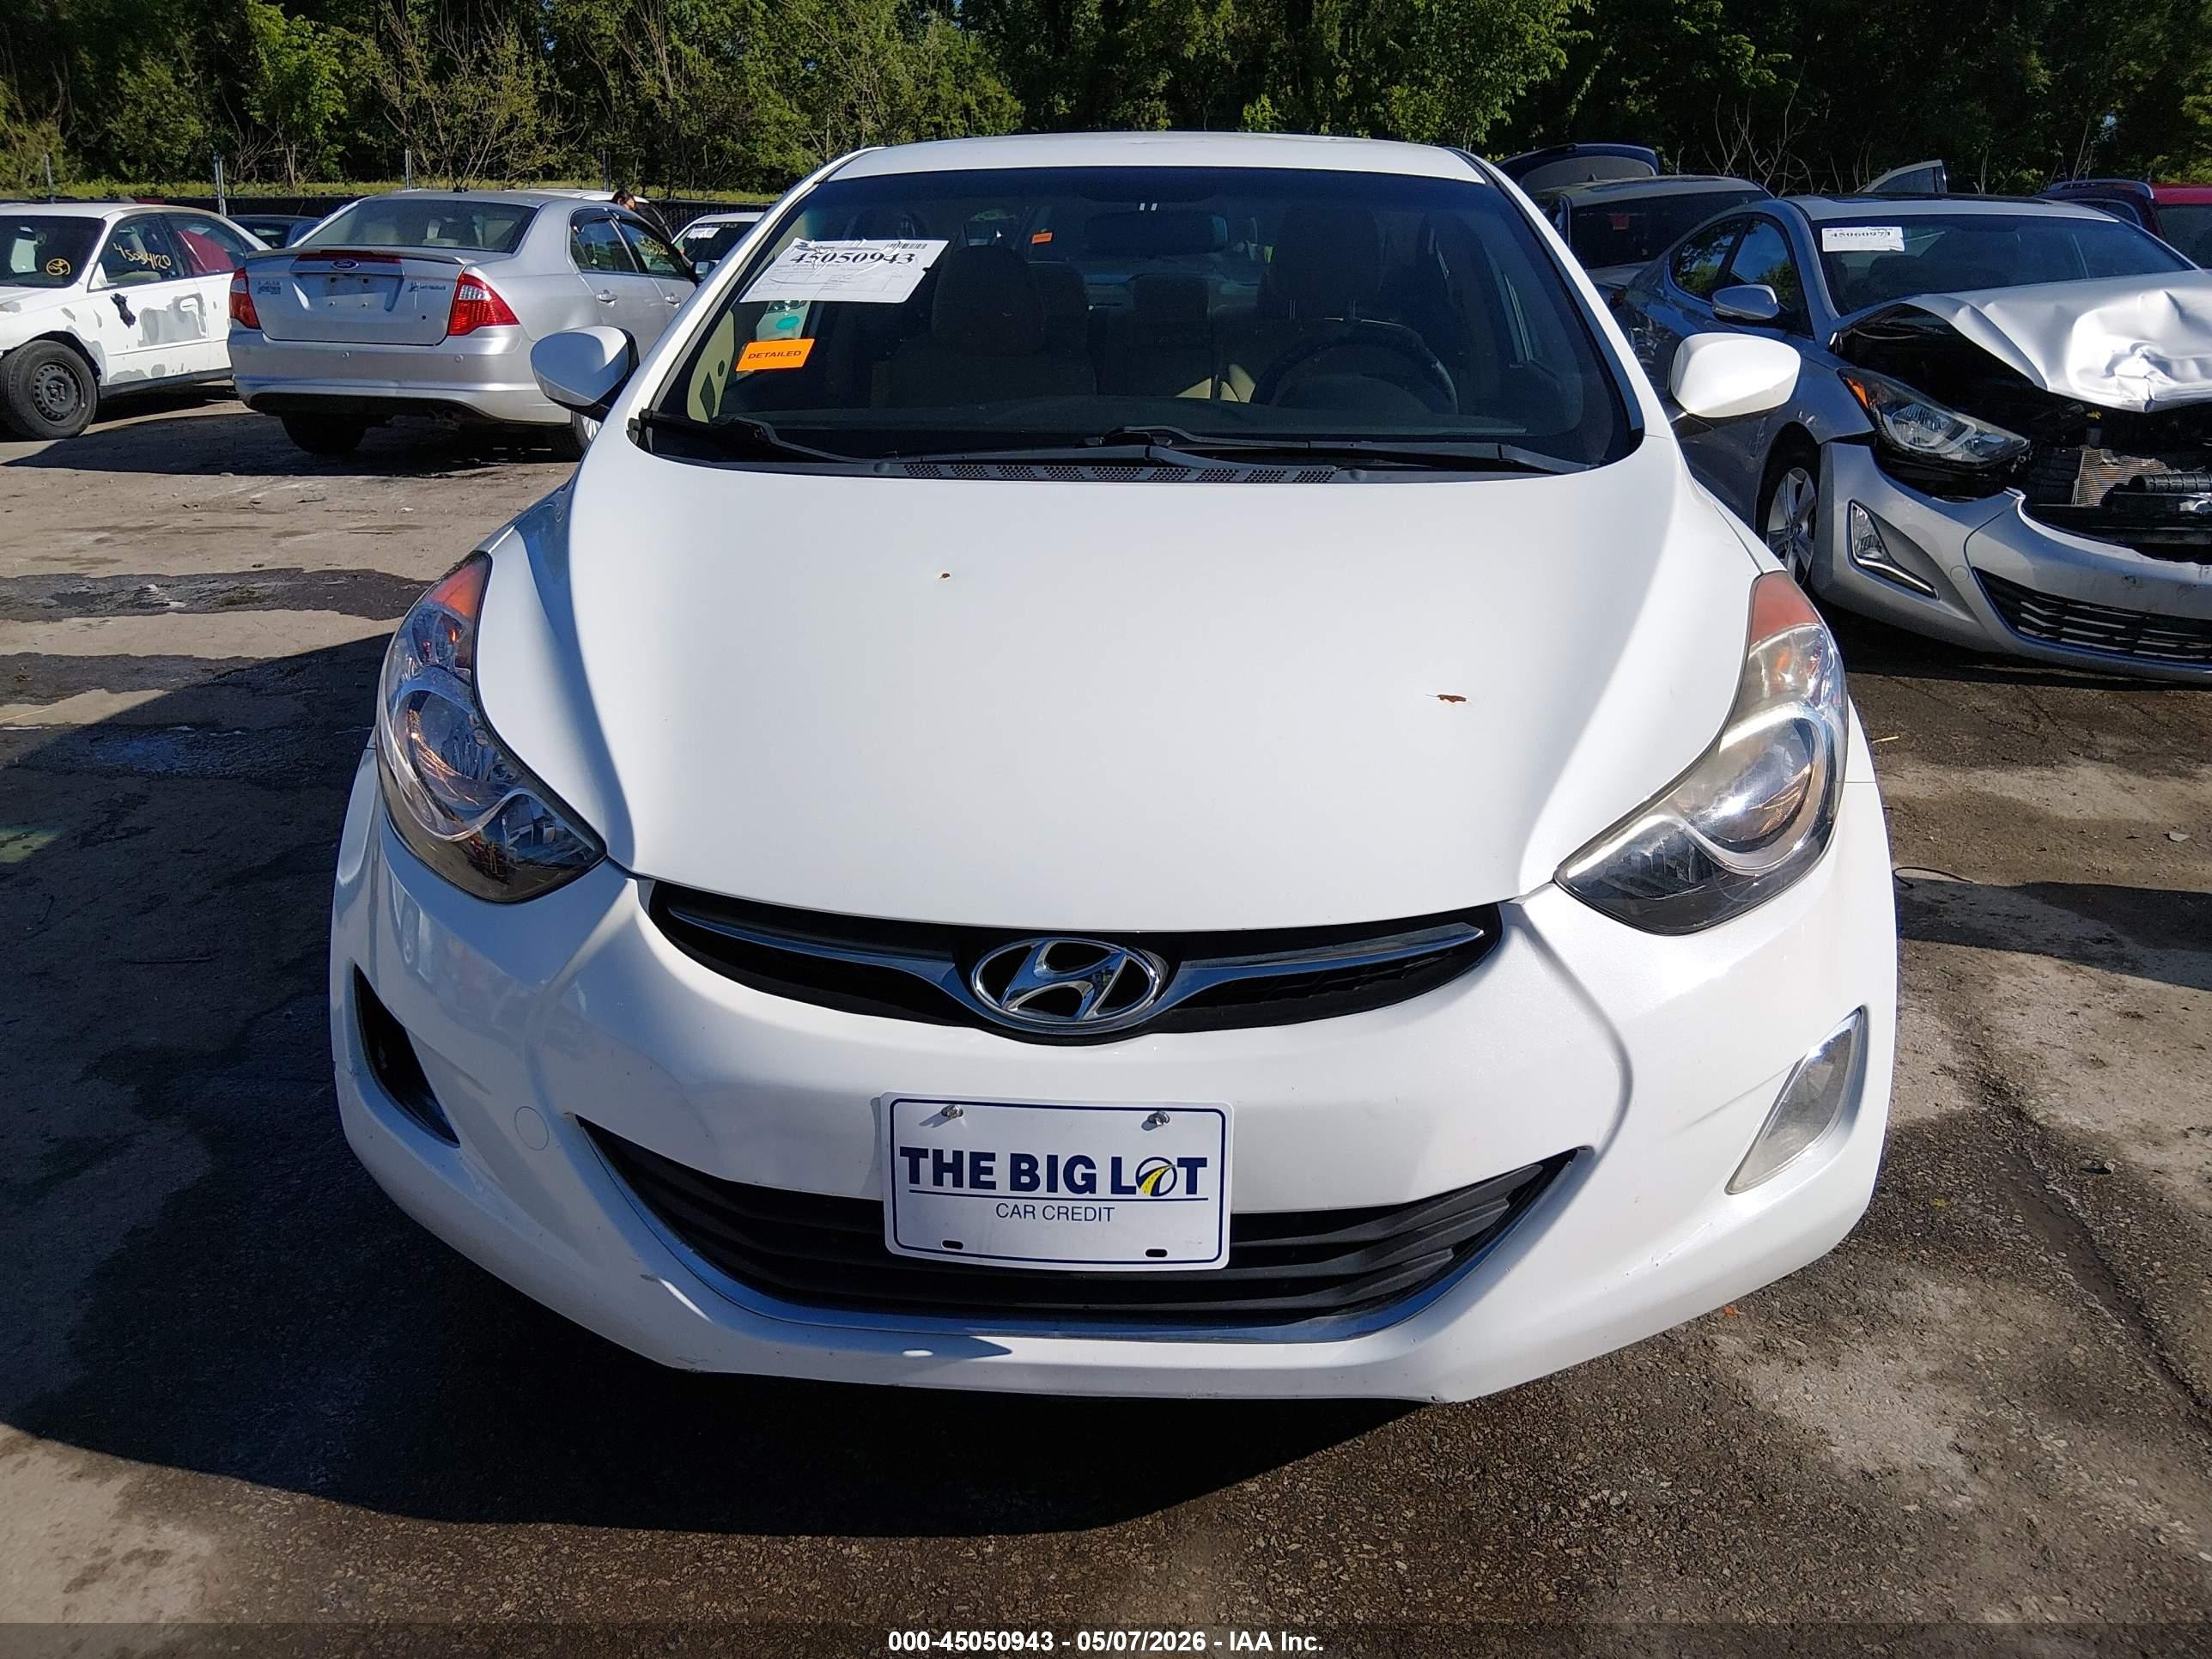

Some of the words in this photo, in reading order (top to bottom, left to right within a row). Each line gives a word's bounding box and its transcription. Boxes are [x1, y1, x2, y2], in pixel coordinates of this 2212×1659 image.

[790, 252, 915, 264] 45050943
[747, 349, 802, 360] DETAILED
[899, 1146, 997, 1190] THE
[1009, 1152, 1097, 1194] BIG
[1110, 1156, 1208, 1197] LOT
[995, 1202, 1036, 1220] CAR
[1042, 1205, 1115, 1222] CREDIT
